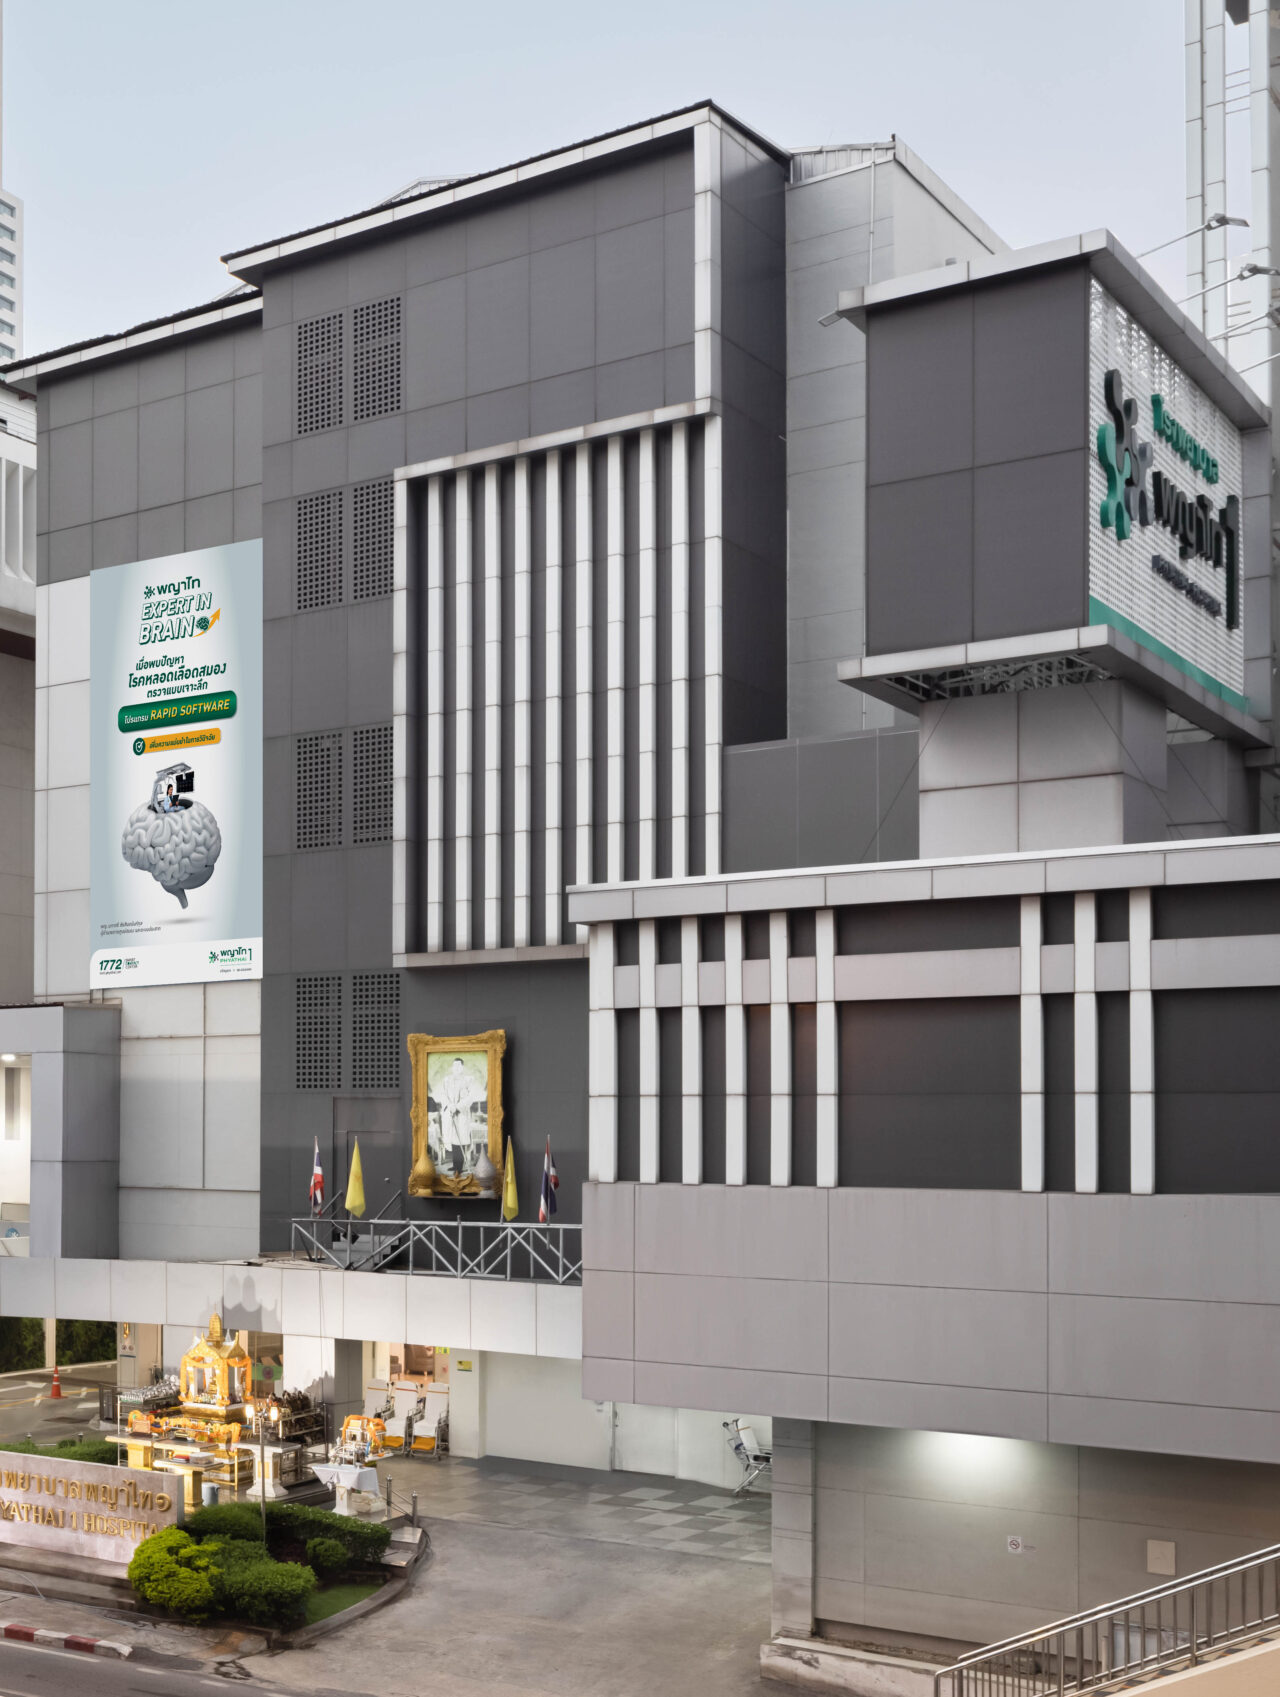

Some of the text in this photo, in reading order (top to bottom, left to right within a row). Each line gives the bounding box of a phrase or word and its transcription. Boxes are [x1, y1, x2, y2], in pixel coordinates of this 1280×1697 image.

[142, 592, 213, 621] EXPERT IN
[139, 615, 195, 645] BRAIN
[128, 662, 227, 688] โรคหลอดเลือดสมอง
[135, 655, 185, 671] เมื่อพบปัญหา
[146, 678, 208, 698] ตรวจแบบเจาะลึก
[124, 699, 231, 725] โปรแกรม RAPID SOFTWARE
[99, 958, 122, 971] 1772
[70, 1511, 78, 1530] 1
[82, 1512, 168, 1542] HOSPITA
